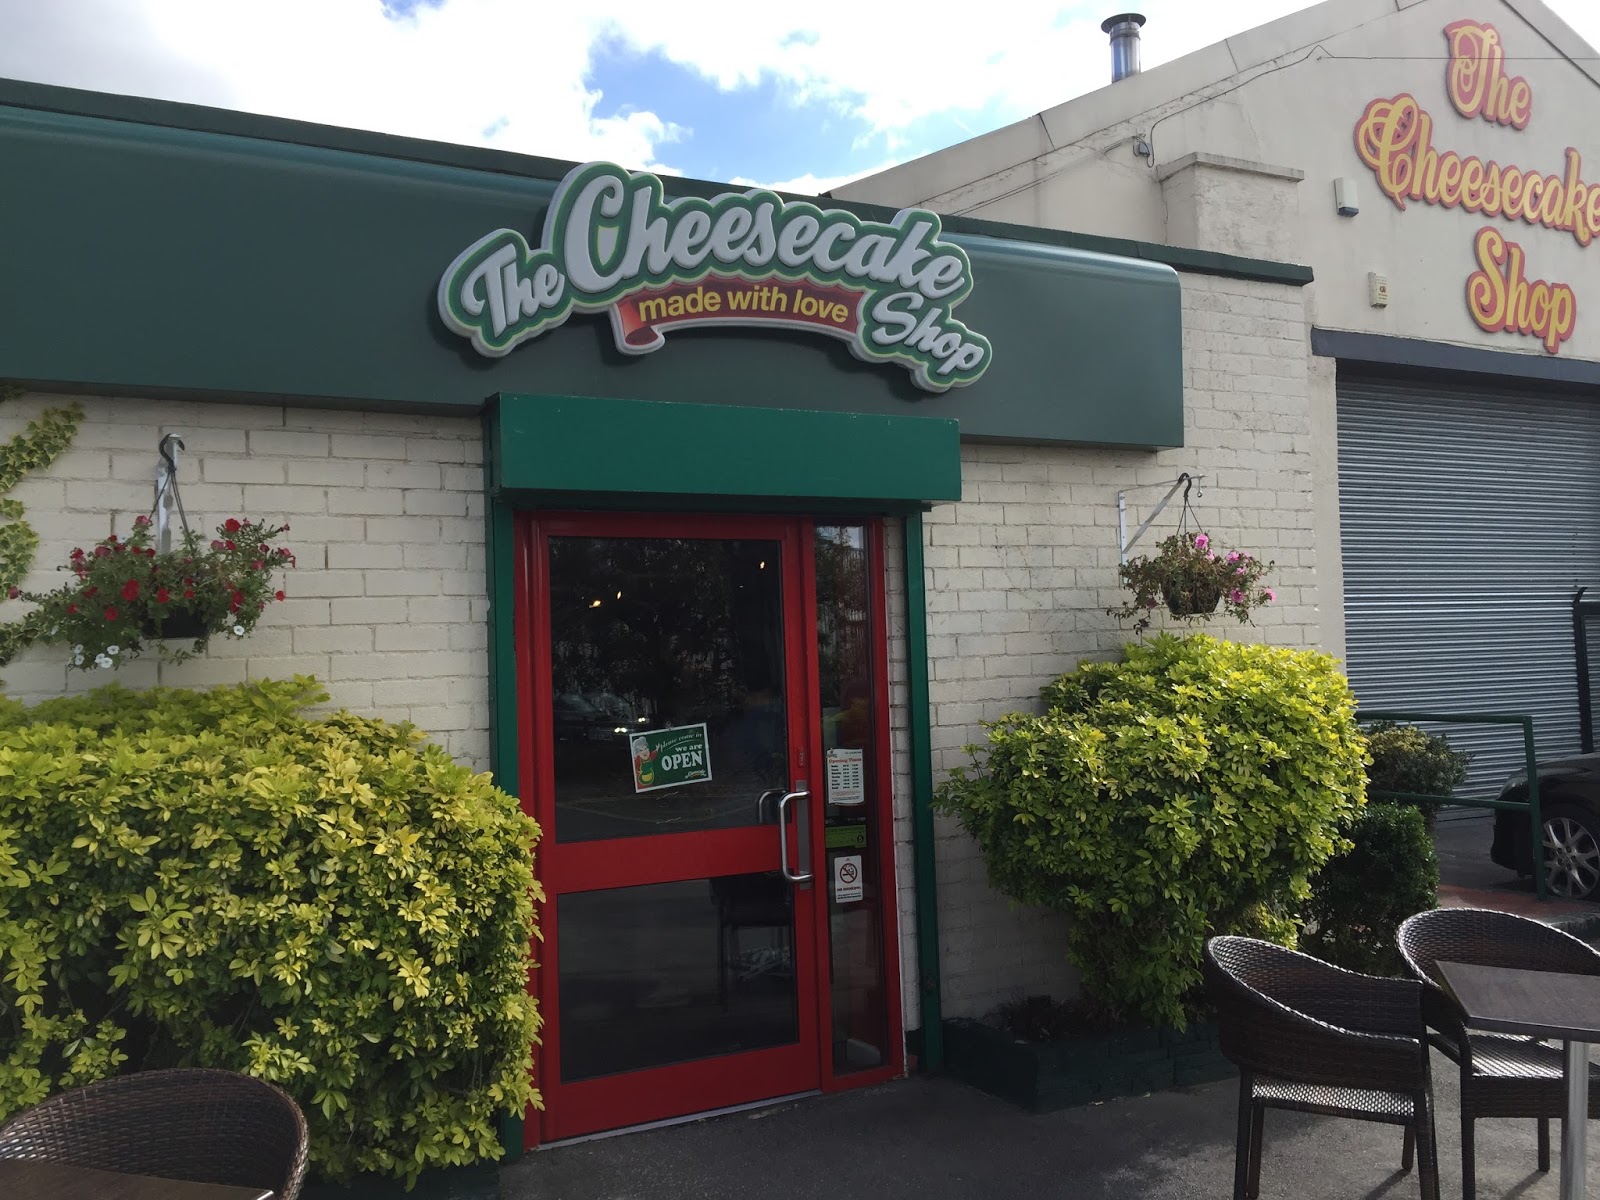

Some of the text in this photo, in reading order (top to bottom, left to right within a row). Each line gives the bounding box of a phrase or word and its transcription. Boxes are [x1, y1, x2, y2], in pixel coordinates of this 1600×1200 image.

[1447, 22, 1530, 128] The
[1356, 95, 1600, 243] Cheesecake
[461, 174, 966, 338] The Cheesecake
[638, 286, 850, 324] made with love
[1469, 229, 1574, 349] Shop
[871, 291, 984, 375] Shop
[661, 751, 702, 771] OPEN
